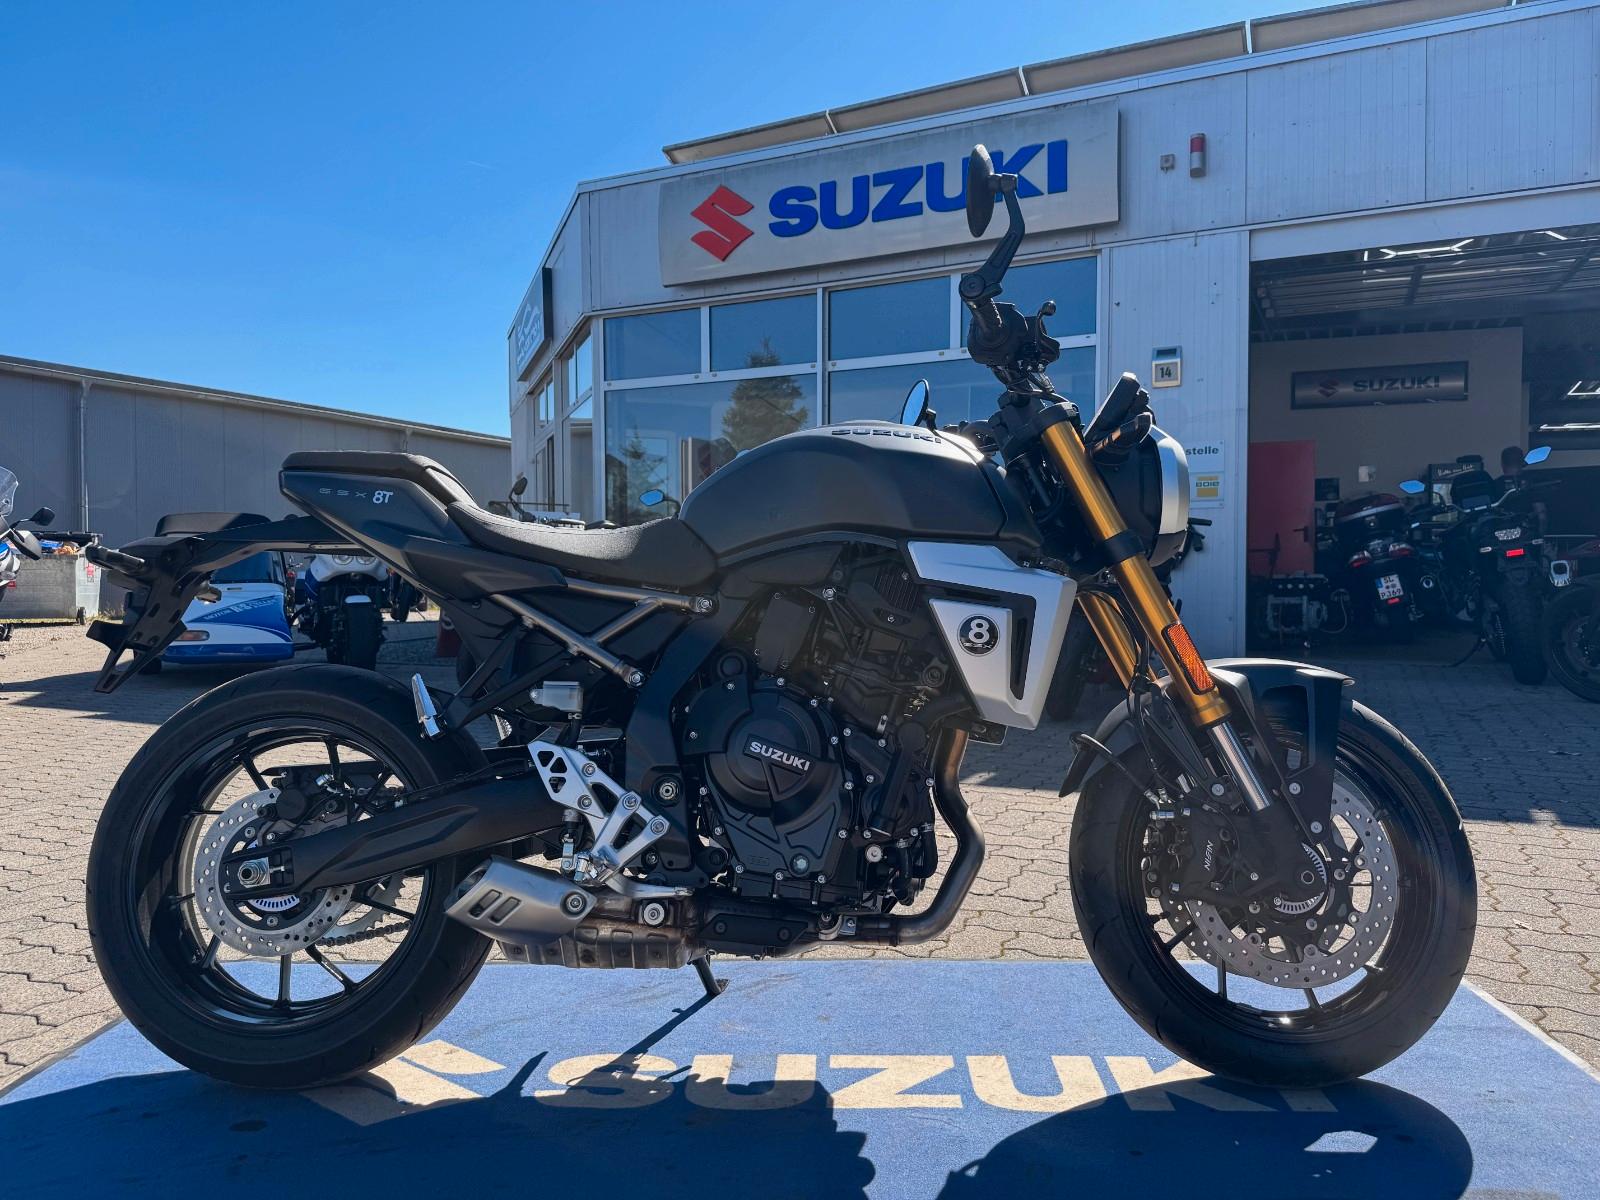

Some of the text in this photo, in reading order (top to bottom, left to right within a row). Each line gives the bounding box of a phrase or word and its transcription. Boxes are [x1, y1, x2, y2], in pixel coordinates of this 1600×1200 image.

[768, 139, 1068, 239] SUZUKI
[1160, 366, 1172, 379] 14
[1353, 375, 1440, 393] SUZUKI
[831, 428, 942, 445] SUZUKI
[372, 490, 394, 504] 8T
[968, 618, 990, 644] 8
[749, 741, 811, 771] SUZUKI
